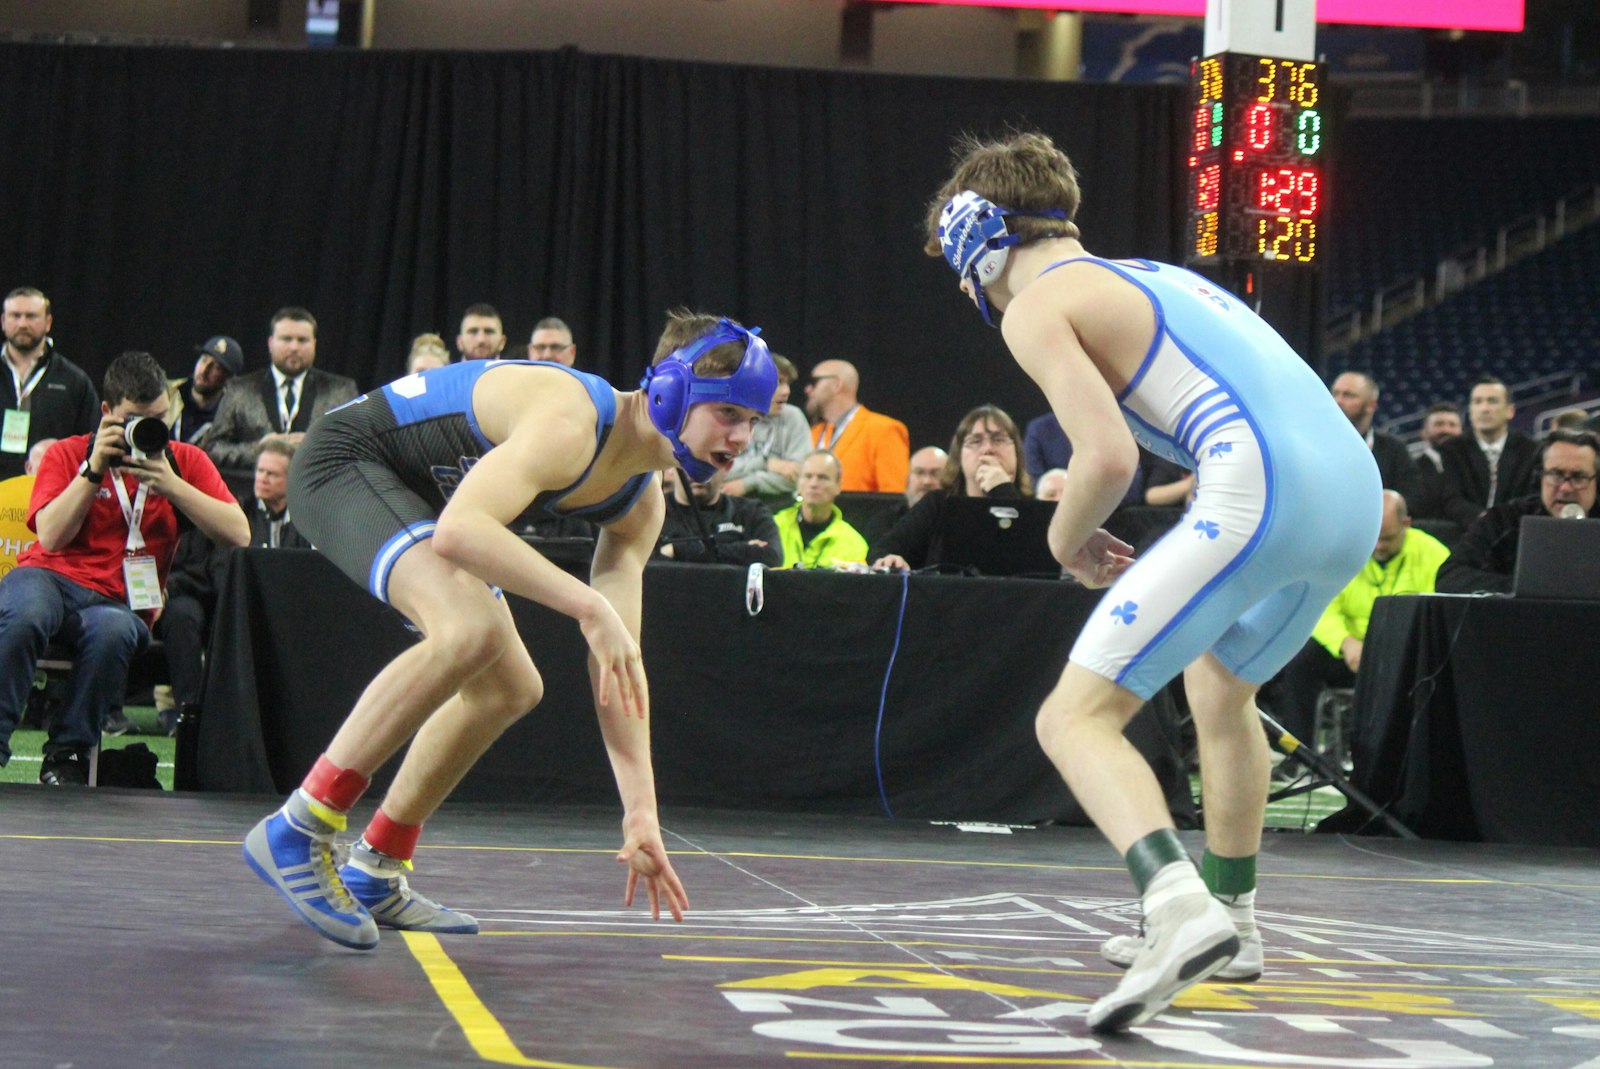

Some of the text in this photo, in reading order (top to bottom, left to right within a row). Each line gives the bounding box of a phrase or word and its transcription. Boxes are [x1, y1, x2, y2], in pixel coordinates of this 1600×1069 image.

[1258, 58, 1318, 108] 376
[1249, 105, 1271, 149] 0
[1298, 109, 1320, 155] 0
[1258, 216, 1316, 263] 120
